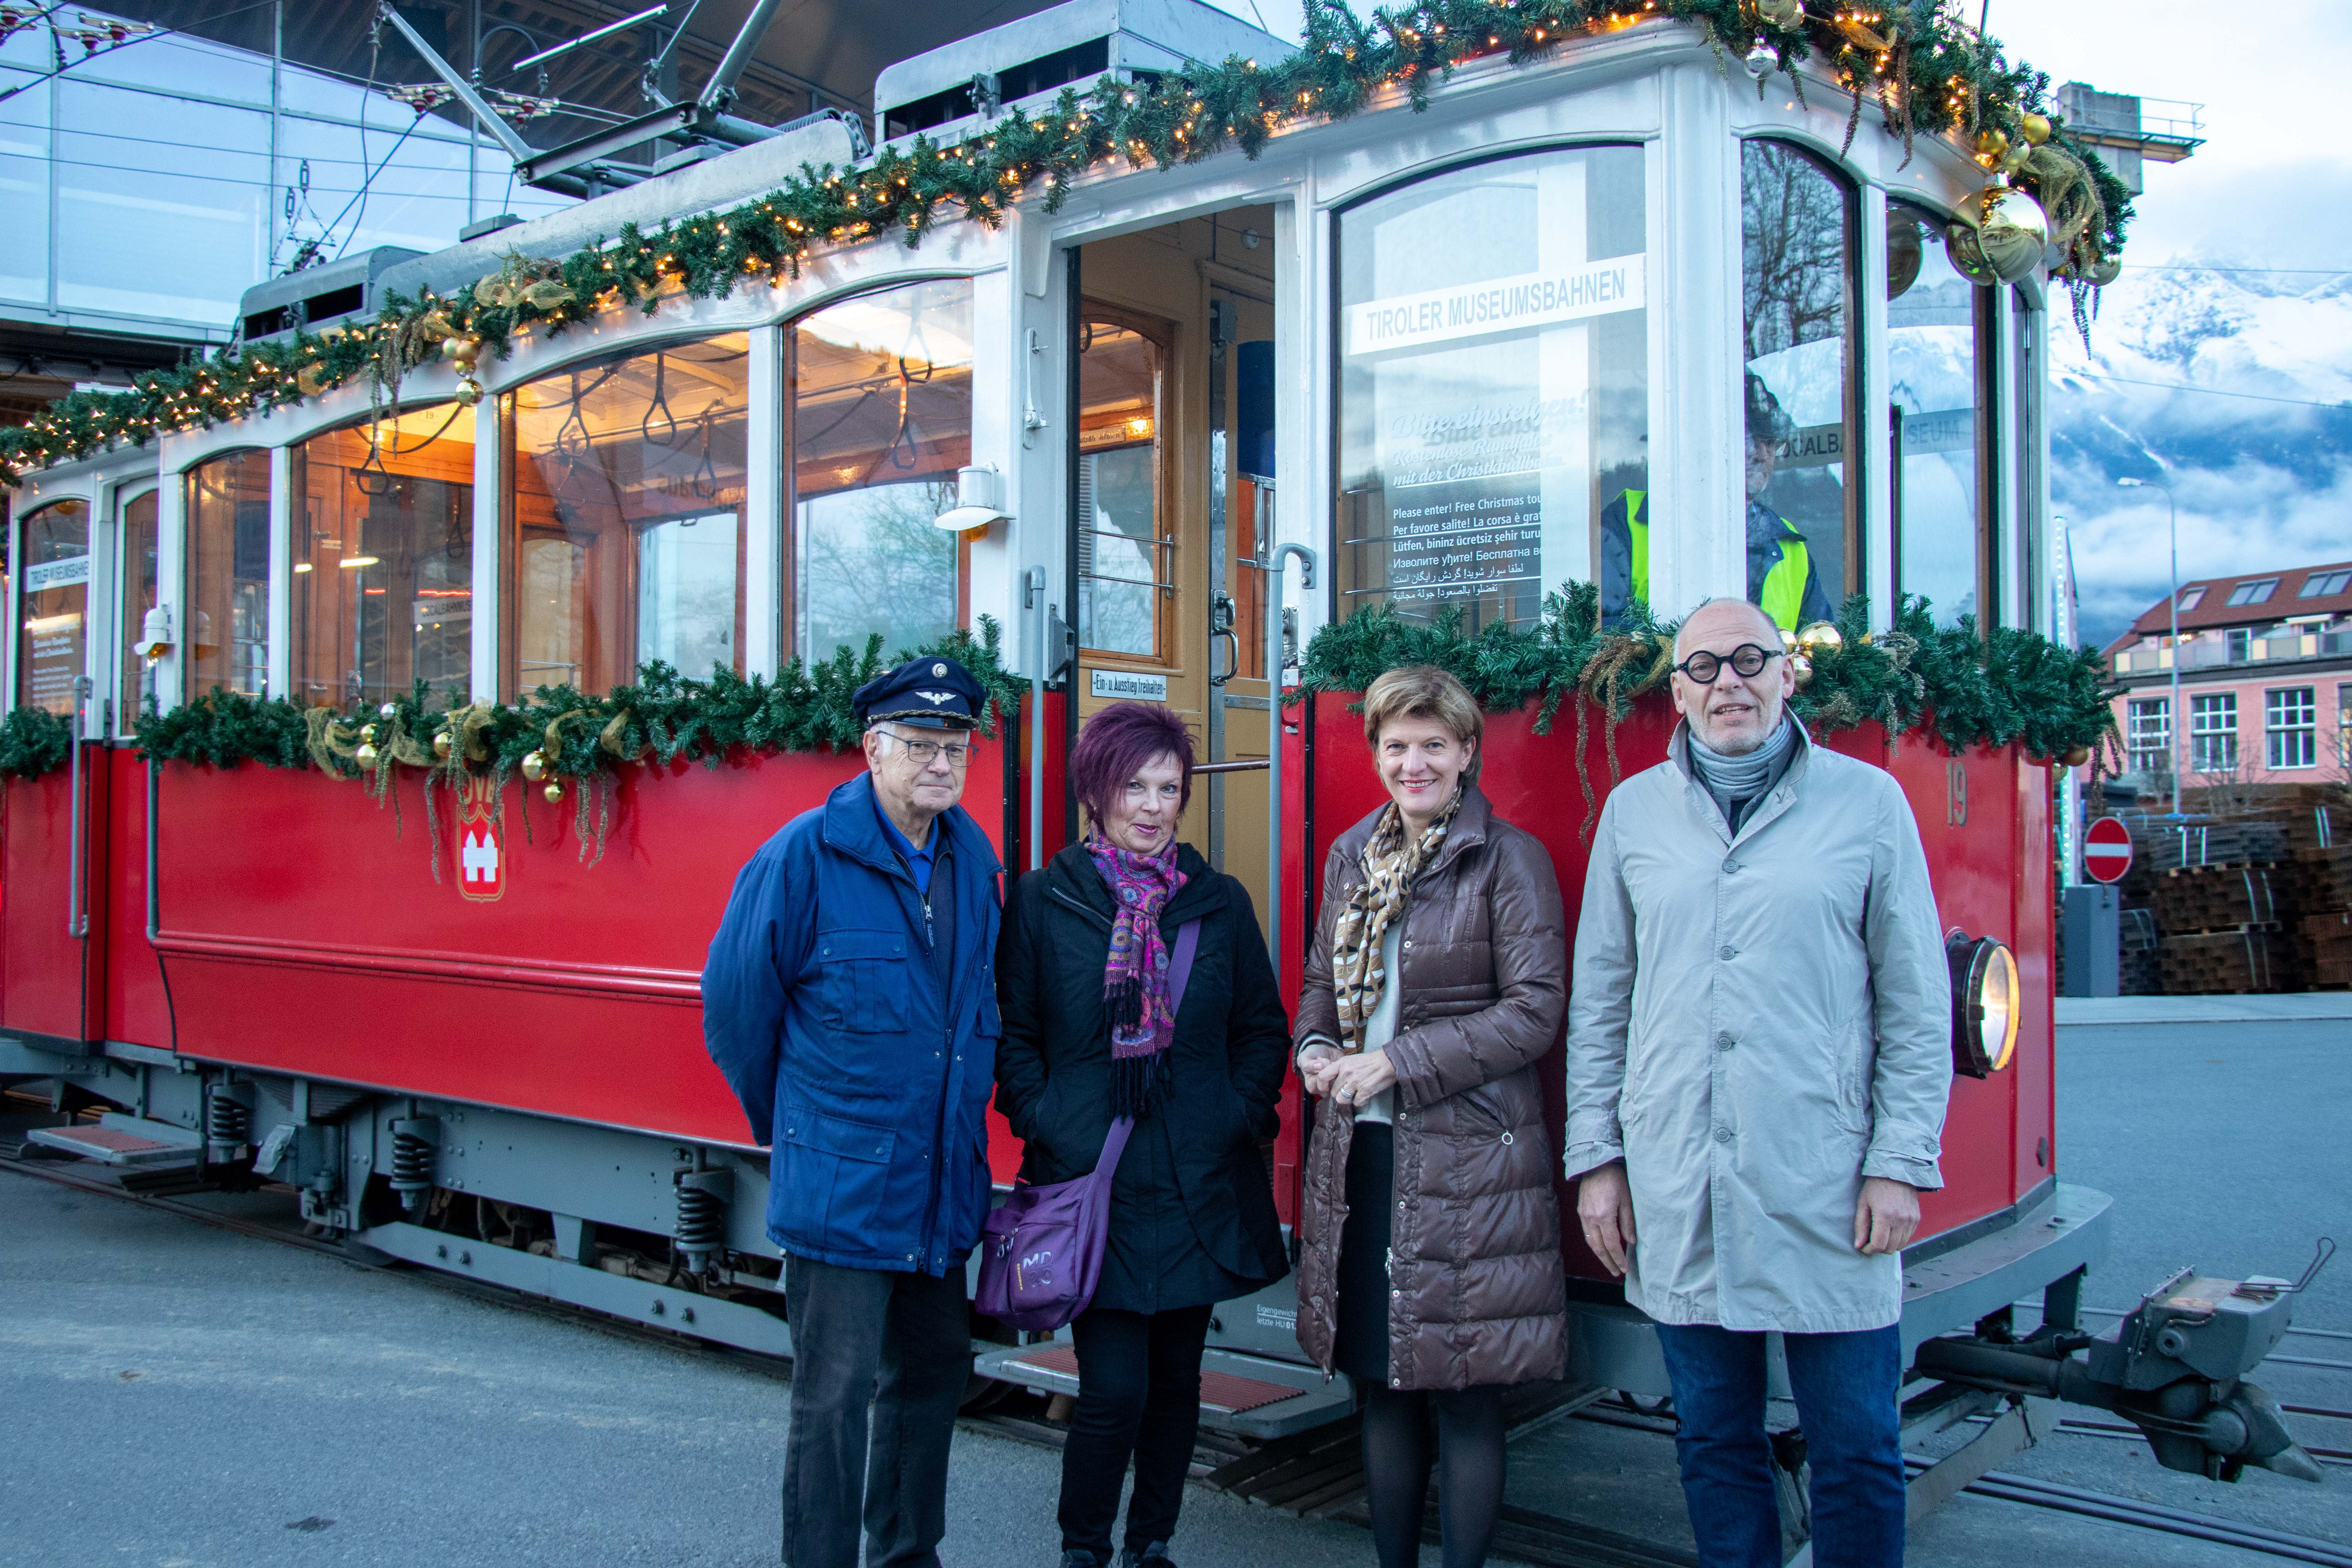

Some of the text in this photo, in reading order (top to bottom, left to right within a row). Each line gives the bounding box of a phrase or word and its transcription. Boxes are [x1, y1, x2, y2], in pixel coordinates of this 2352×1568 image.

[1367, 268, 1625, 340] TIROLER MUSEUMSBAHNEN
[425, 411, 434, 419] 19
[1390, 412, 1451, 439] Bitte
[1904, 420, 1959, 445] SEUM
[1394, 444, 1469, 466] Kostenlose
[1393, 470, 1417, 486] mit
[1419, 468, 1443, 482] der
[1393, 494, 1541, 519] Please enter! Free Christmas tou
[1393, 511, 1541, 535] Per favore salite! La corsa è grat
[1393, 541, 1424, 552] Lütfen,
[1426, 537, 1454, 549] bininz
[1456, 533, 1492, 546] ücretsiz
[1495, 530, 1518, 544] şehir
[1393, 557, 1439, 568] Изволите
[1442, 552, 1473, 567] уђите!
[1476, 548, 1530, 561] Бесплатна
[1508, 563, 1523, 573] لطفا
[1393, 574, 1409, 583] است
[1487, 566, 1506, 577] سوار
[1109, 679, 1113, 691] u.
[1114, 675, 1137, 695] Ausstieg
[1138, 678, 1163, 695] freihalten
[1946, 761, 1968, 828] 19
[1022, 1251, 1053, 1269] MD
[1257, 1316, 1274, 1326] letzte
[1276, 1319, 1285, 1327] HU
